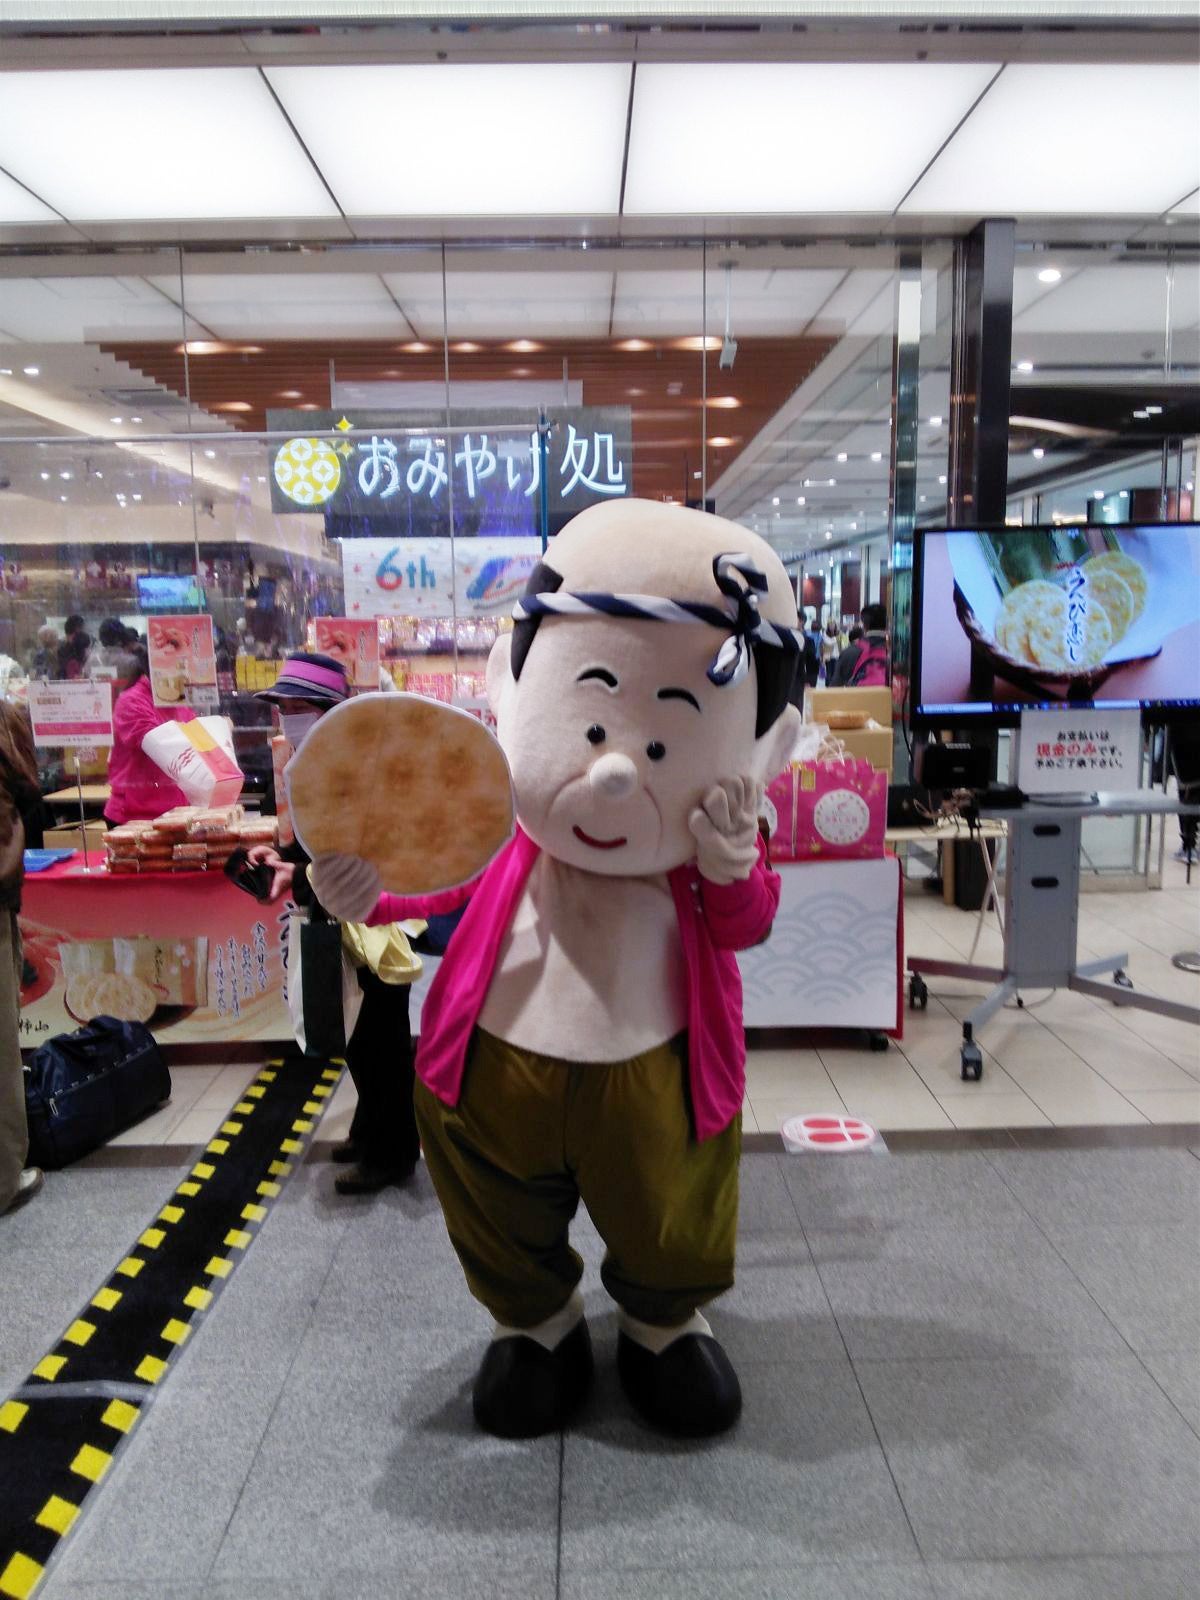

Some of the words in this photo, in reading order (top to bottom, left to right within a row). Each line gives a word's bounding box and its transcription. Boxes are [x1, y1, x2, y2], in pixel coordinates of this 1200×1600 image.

[358, 424, 626, 498] おみやげ処
[376, 547, 436, 590] 6th
[1057, 731, 1109, 741] お支払いは
